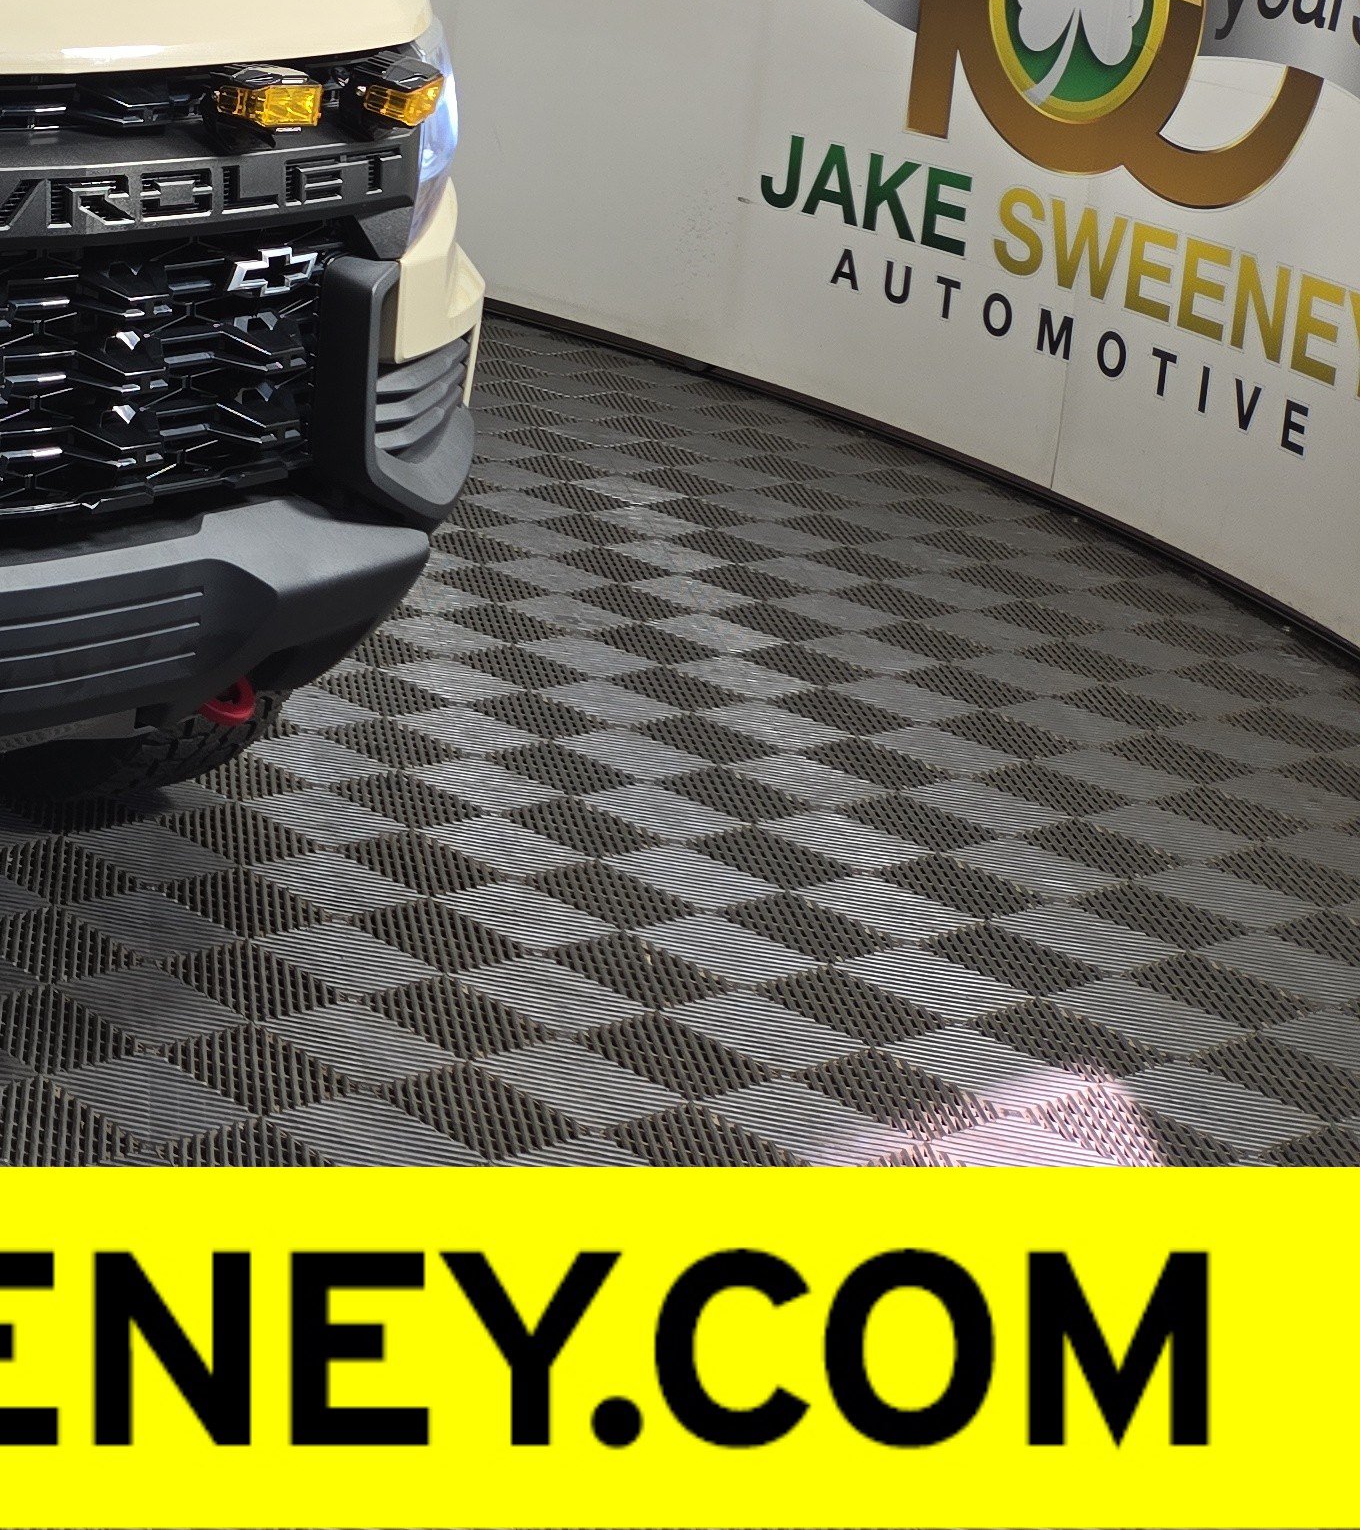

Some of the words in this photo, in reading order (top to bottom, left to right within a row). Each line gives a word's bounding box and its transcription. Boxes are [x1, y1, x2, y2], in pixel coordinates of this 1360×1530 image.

[760, 134, 974, 257] JAKE
[992, 187, 1360, 398] SWEENE
[830, 247, 1310, 456] AUTOMOTIVE
